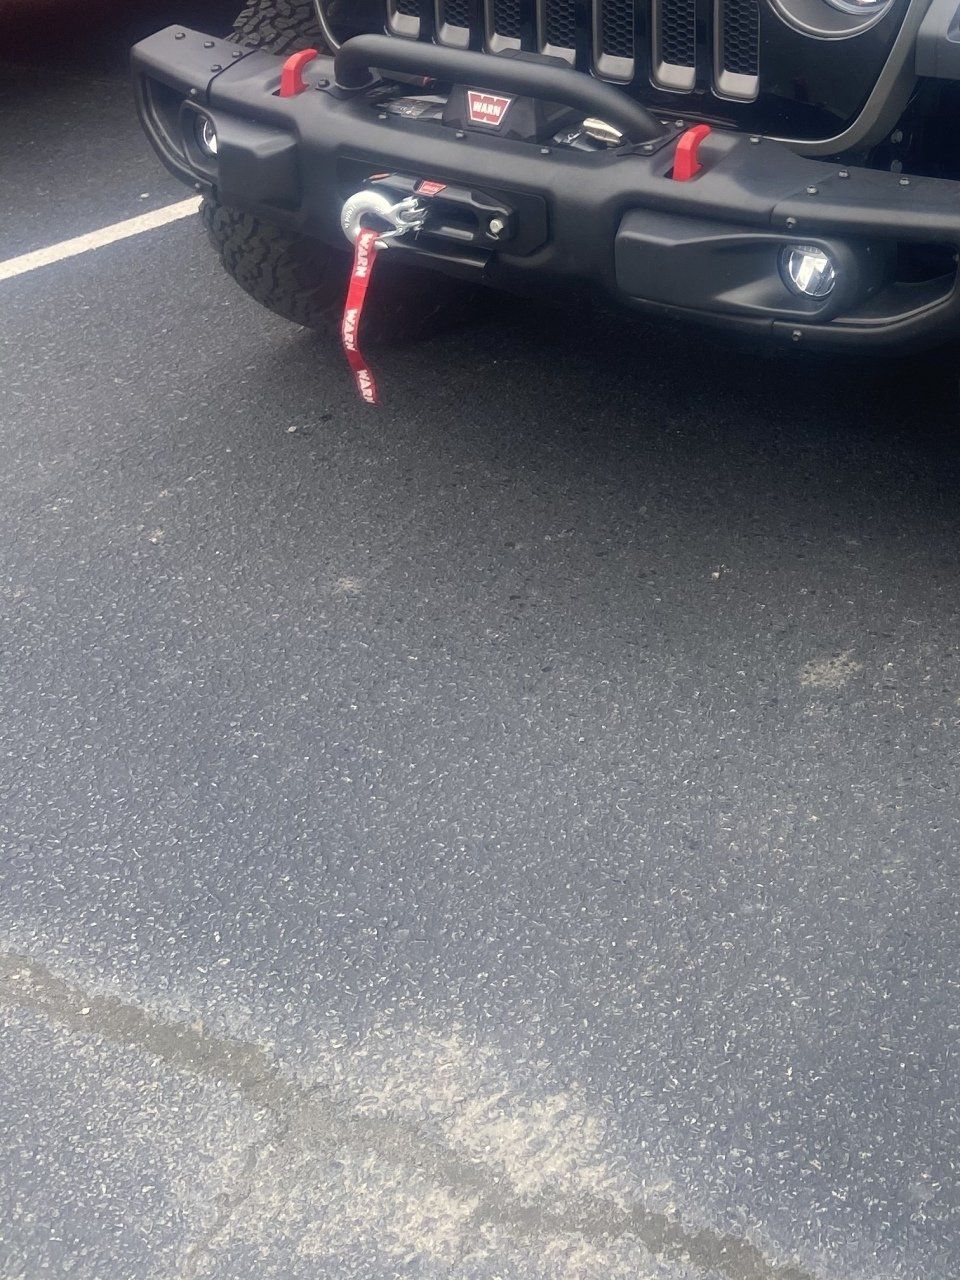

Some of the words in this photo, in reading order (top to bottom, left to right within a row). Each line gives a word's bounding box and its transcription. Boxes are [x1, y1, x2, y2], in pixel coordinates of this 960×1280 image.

[472, 101, 501, 117] WARN
[355, 233, 374, 278] WARN
[343, 308, 358, 352] WARN
[357, 369, 376, 404] WARN
